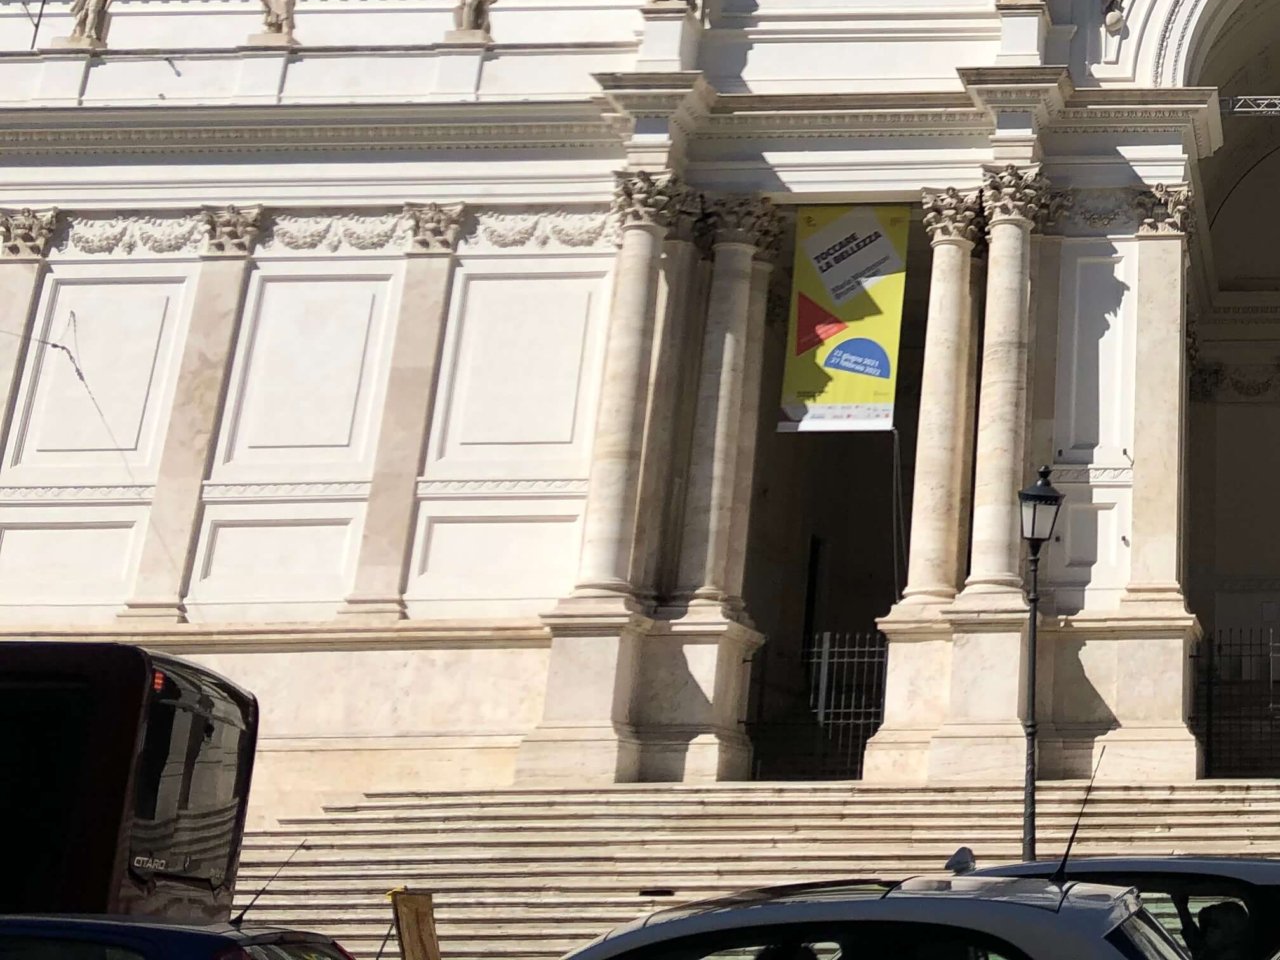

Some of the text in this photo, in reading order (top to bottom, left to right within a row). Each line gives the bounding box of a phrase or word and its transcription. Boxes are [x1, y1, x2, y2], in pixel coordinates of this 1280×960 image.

[813, 232, 860, 264] TOCCARE
[819, 231, 882, 273] LA BELLEZZA
[133, 856, 166, 870] CITARO
